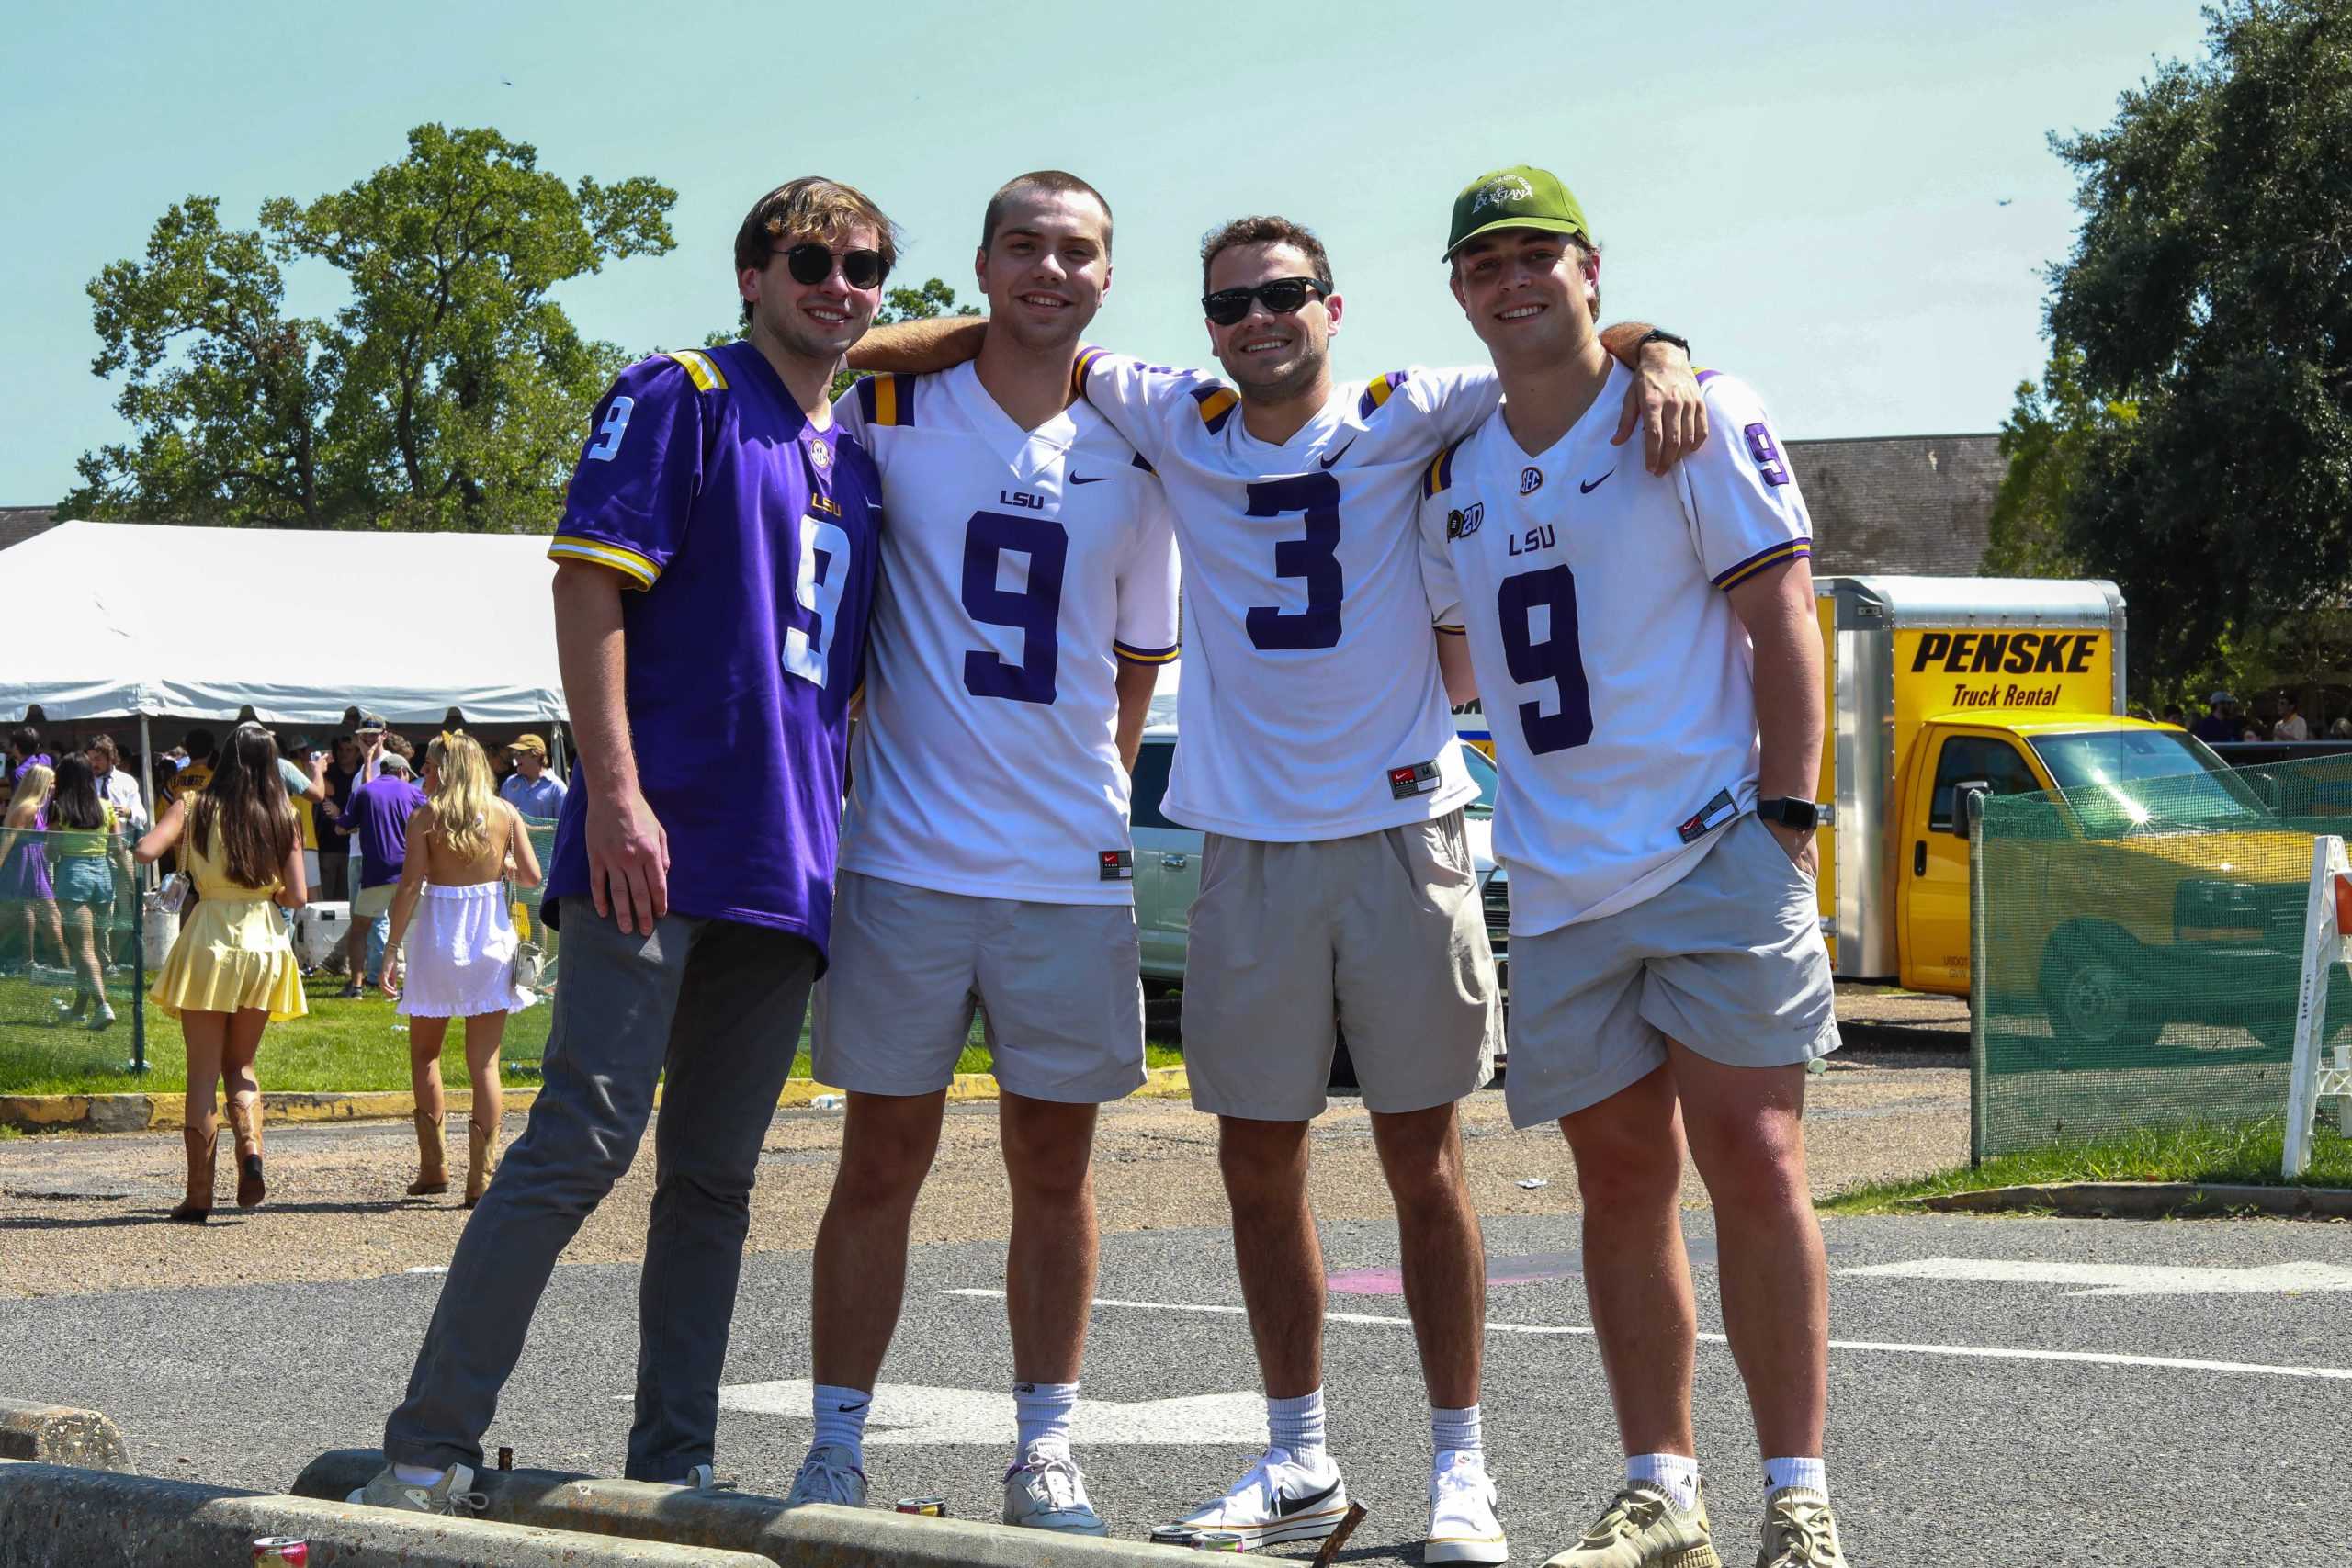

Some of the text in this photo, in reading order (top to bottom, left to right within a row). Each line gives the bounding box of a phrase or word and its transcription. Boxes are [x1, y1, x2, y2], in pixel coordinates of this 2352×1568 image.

[588, 396, 634, 462] 9
[1744, 423, 1790, 487] 9
[1000, 490, 1044, 509] LSU
[1521, 469, 1541, 492] SEC
[811, 492, 842, 517] LSU
[1461, 503, 1483, 536] 20
[1244, 471, 1344, 650] 3
[1509, 524, 1555, 556] LSU
[781, 514, 851, 691] 9
[961, 511, 1069, 705] 9
[1498, 564, 1594, 756] 9
[1911, 633, 2099, 674] PENSKE
[1951, 684, 2062, 706] Truck Rental
